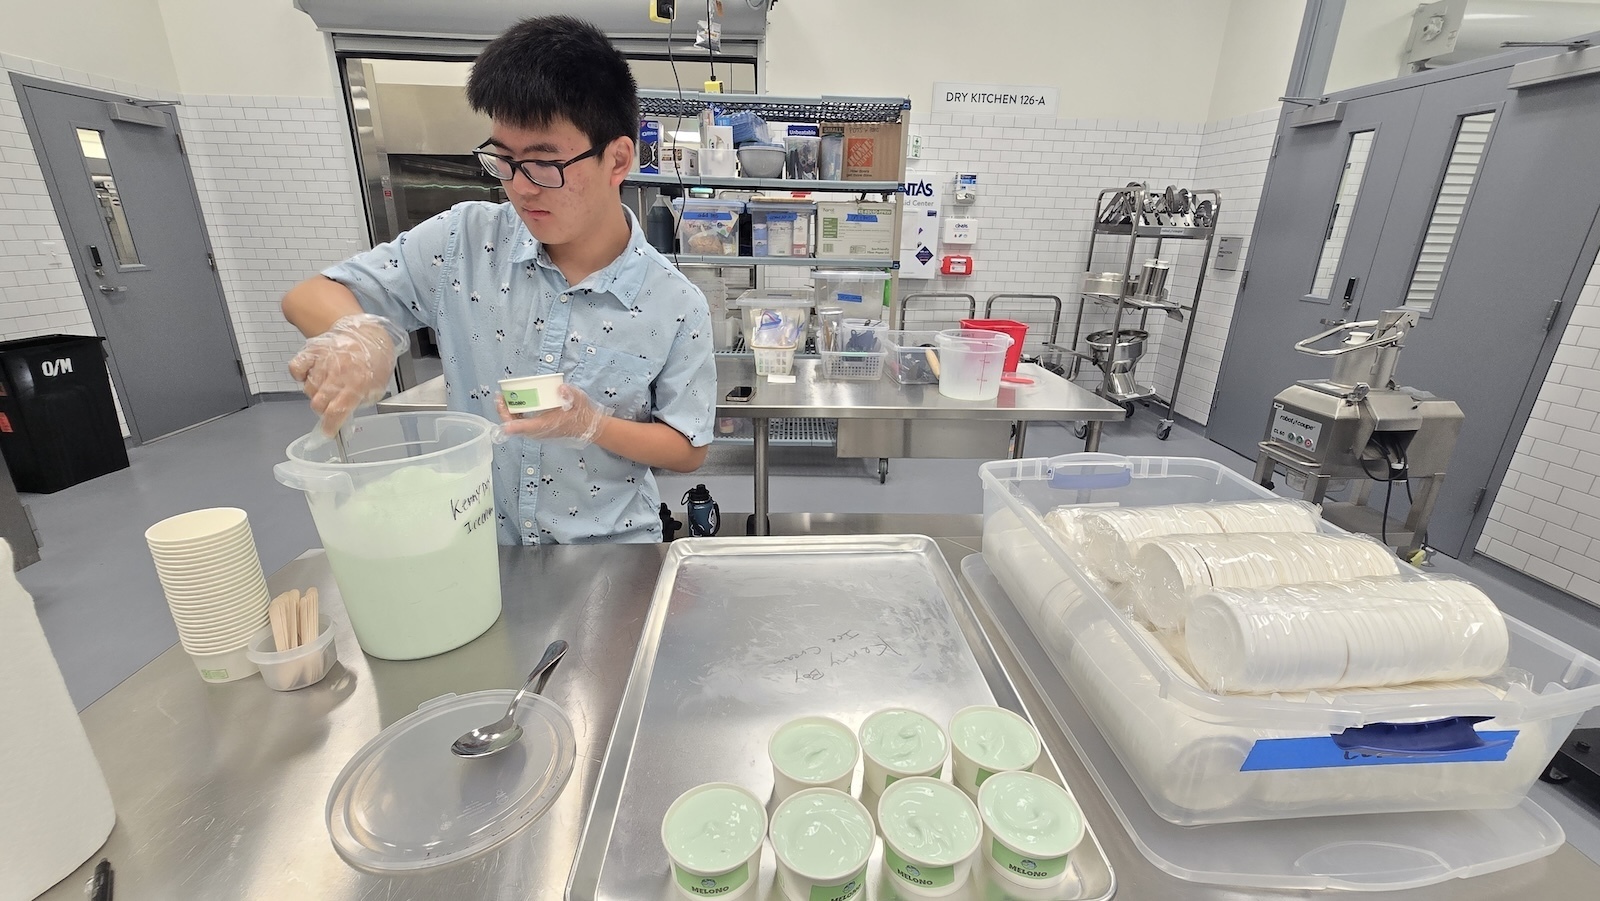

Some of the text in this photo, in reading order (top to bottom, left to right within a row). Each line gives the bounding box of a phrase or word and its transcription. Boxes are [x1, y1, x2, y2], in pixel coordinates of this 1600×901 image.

[946, 92, 1045, 106] DRY KITCHEN 126-A
[847, 138, 874, 167] HOME
[849, 142, 862, 153] THE
[903, 179, 934, 197] NTAS
[41, 357, 73, 377] O/M
[1280, 415, 1314, 431] robot coupe
[773, 629, 860, 665] Ice Cream
[830, 635, 902, 667] Kenny
[897, 868, 933, 886] MELONO
[1008, 863, 1048, 878] MELONO
[691, 886, 730, 895] MELONO
